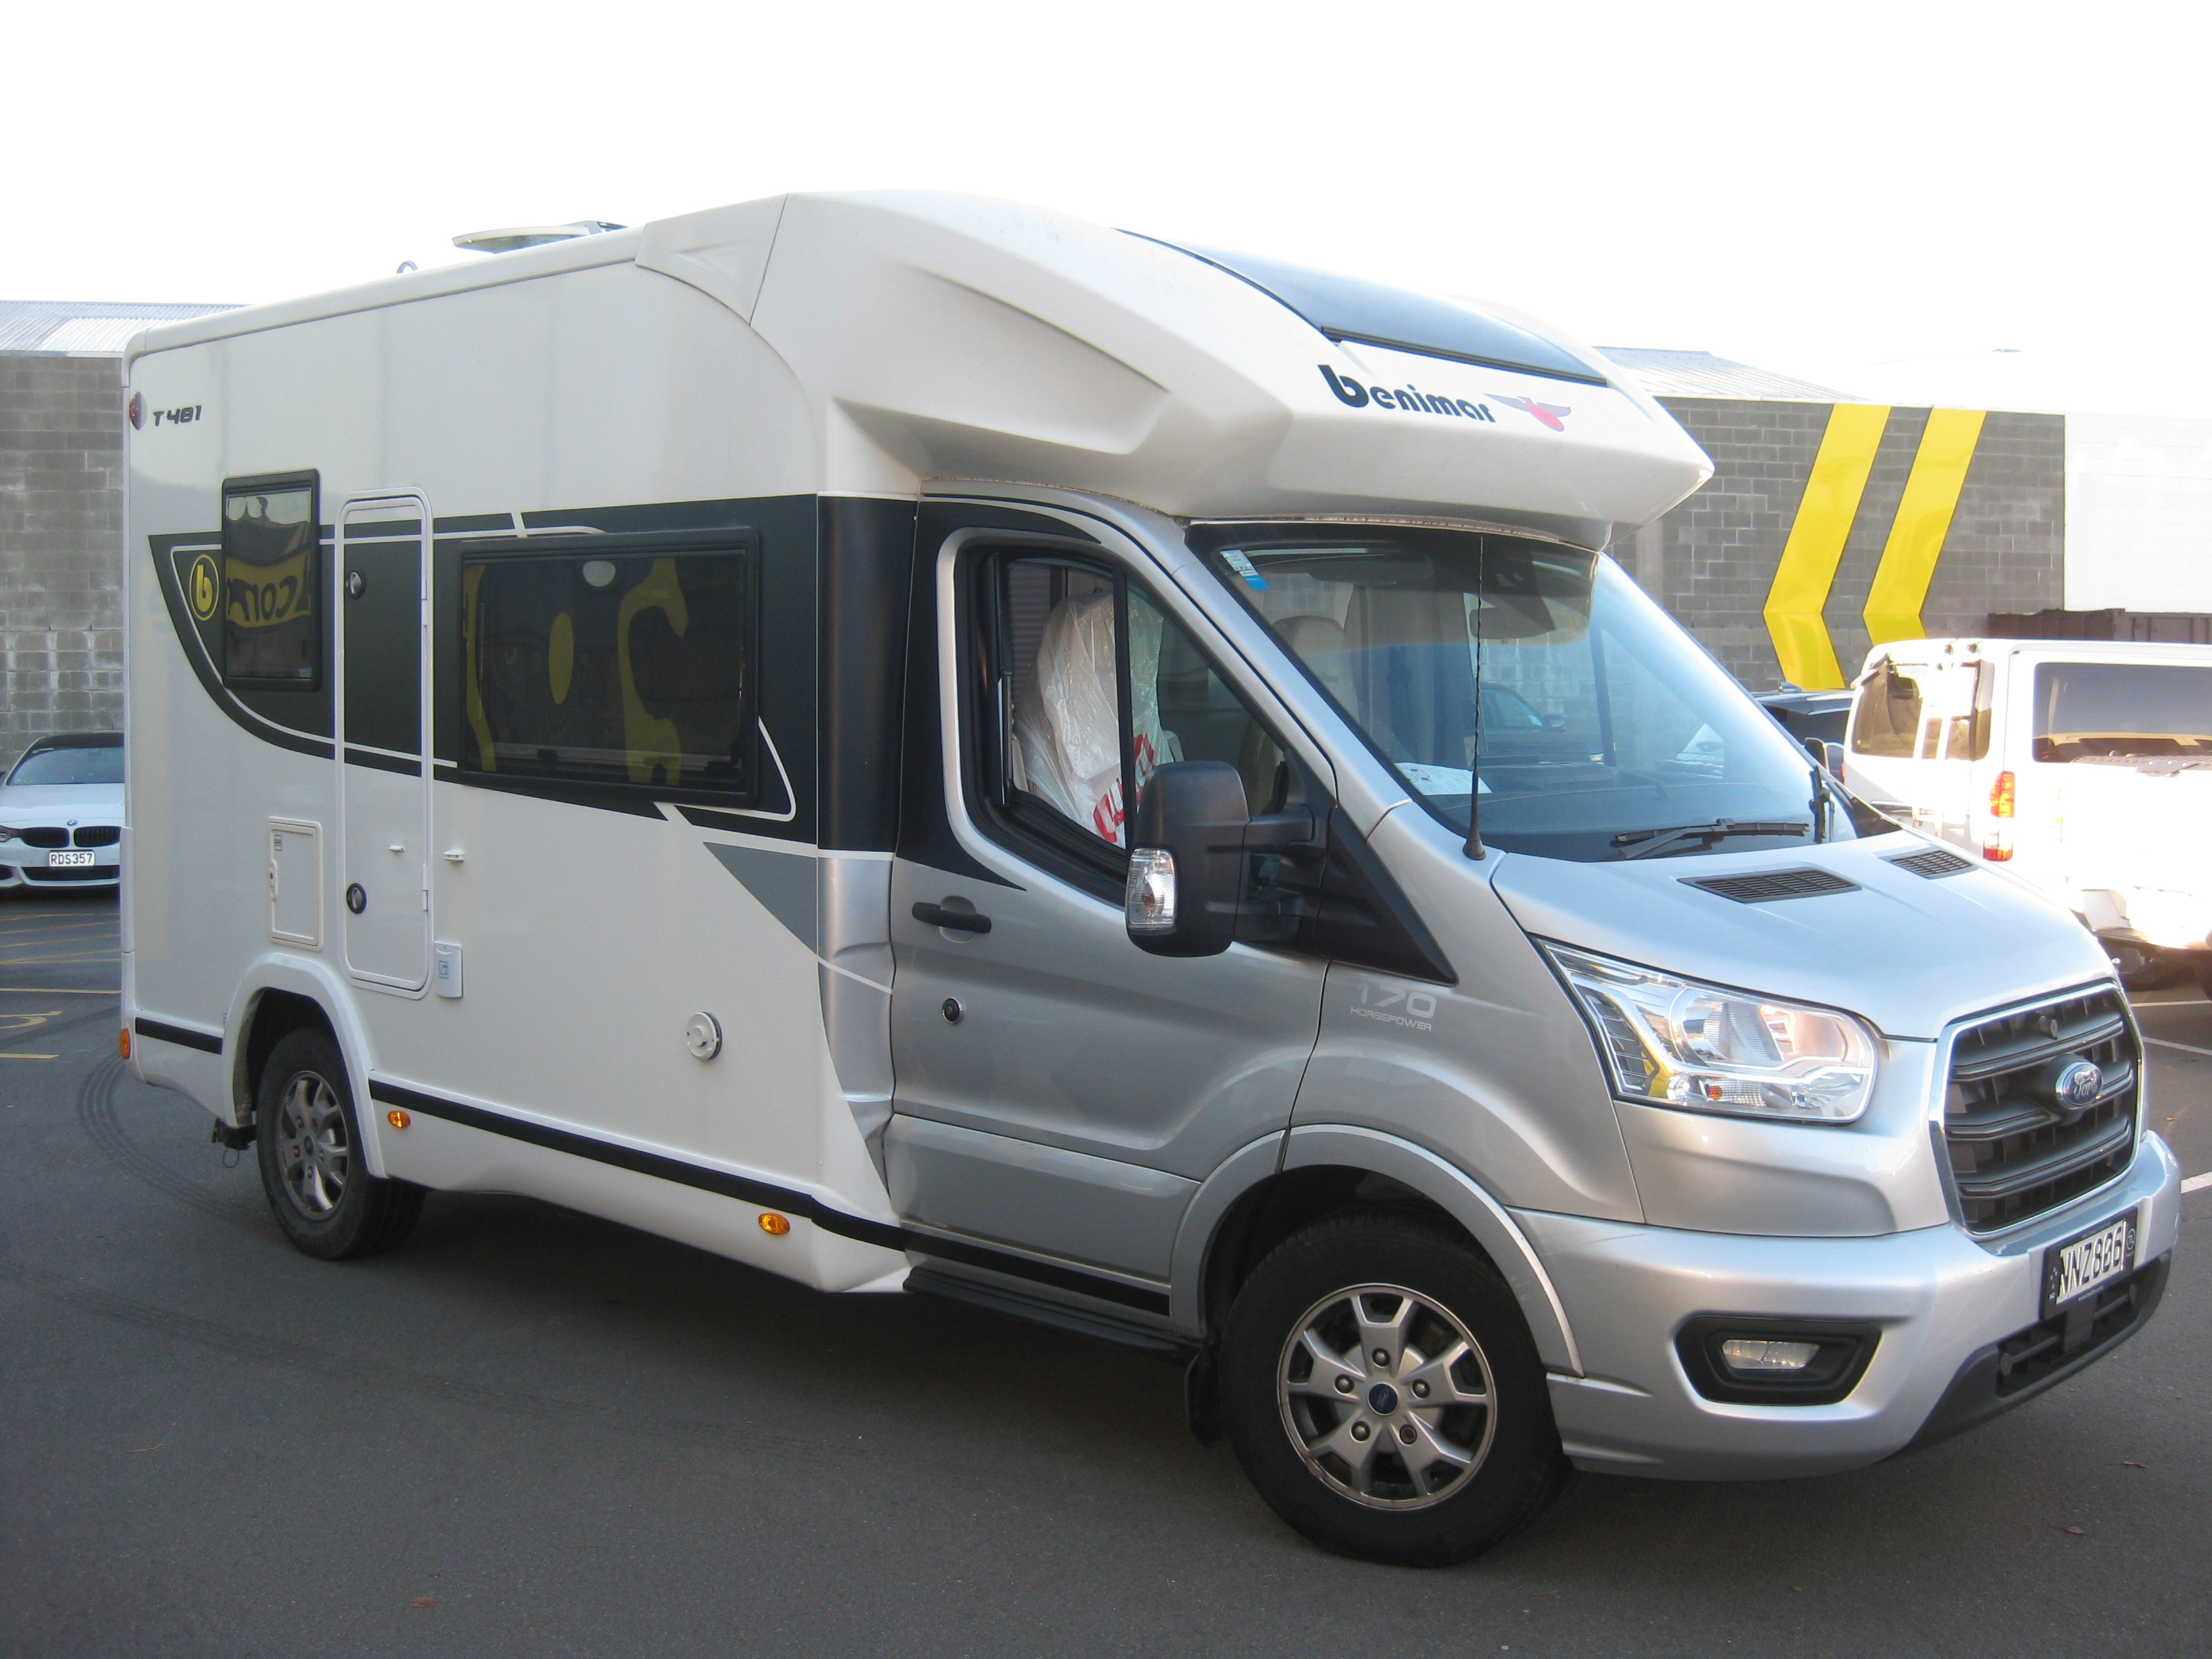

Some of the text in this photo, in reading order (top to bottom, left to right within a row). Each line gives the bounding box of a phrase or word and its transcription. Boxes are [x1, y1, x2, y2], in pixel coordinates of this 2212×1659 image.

[1317, 365, 1496, 423] benimar
[152, 405, 202, 427] T 481
[51, 853, 94, 865] RDS357
[1357, 983, 1437, 1019] 170
[1350, 1006, 1432, 1032] HORSEPOWER
